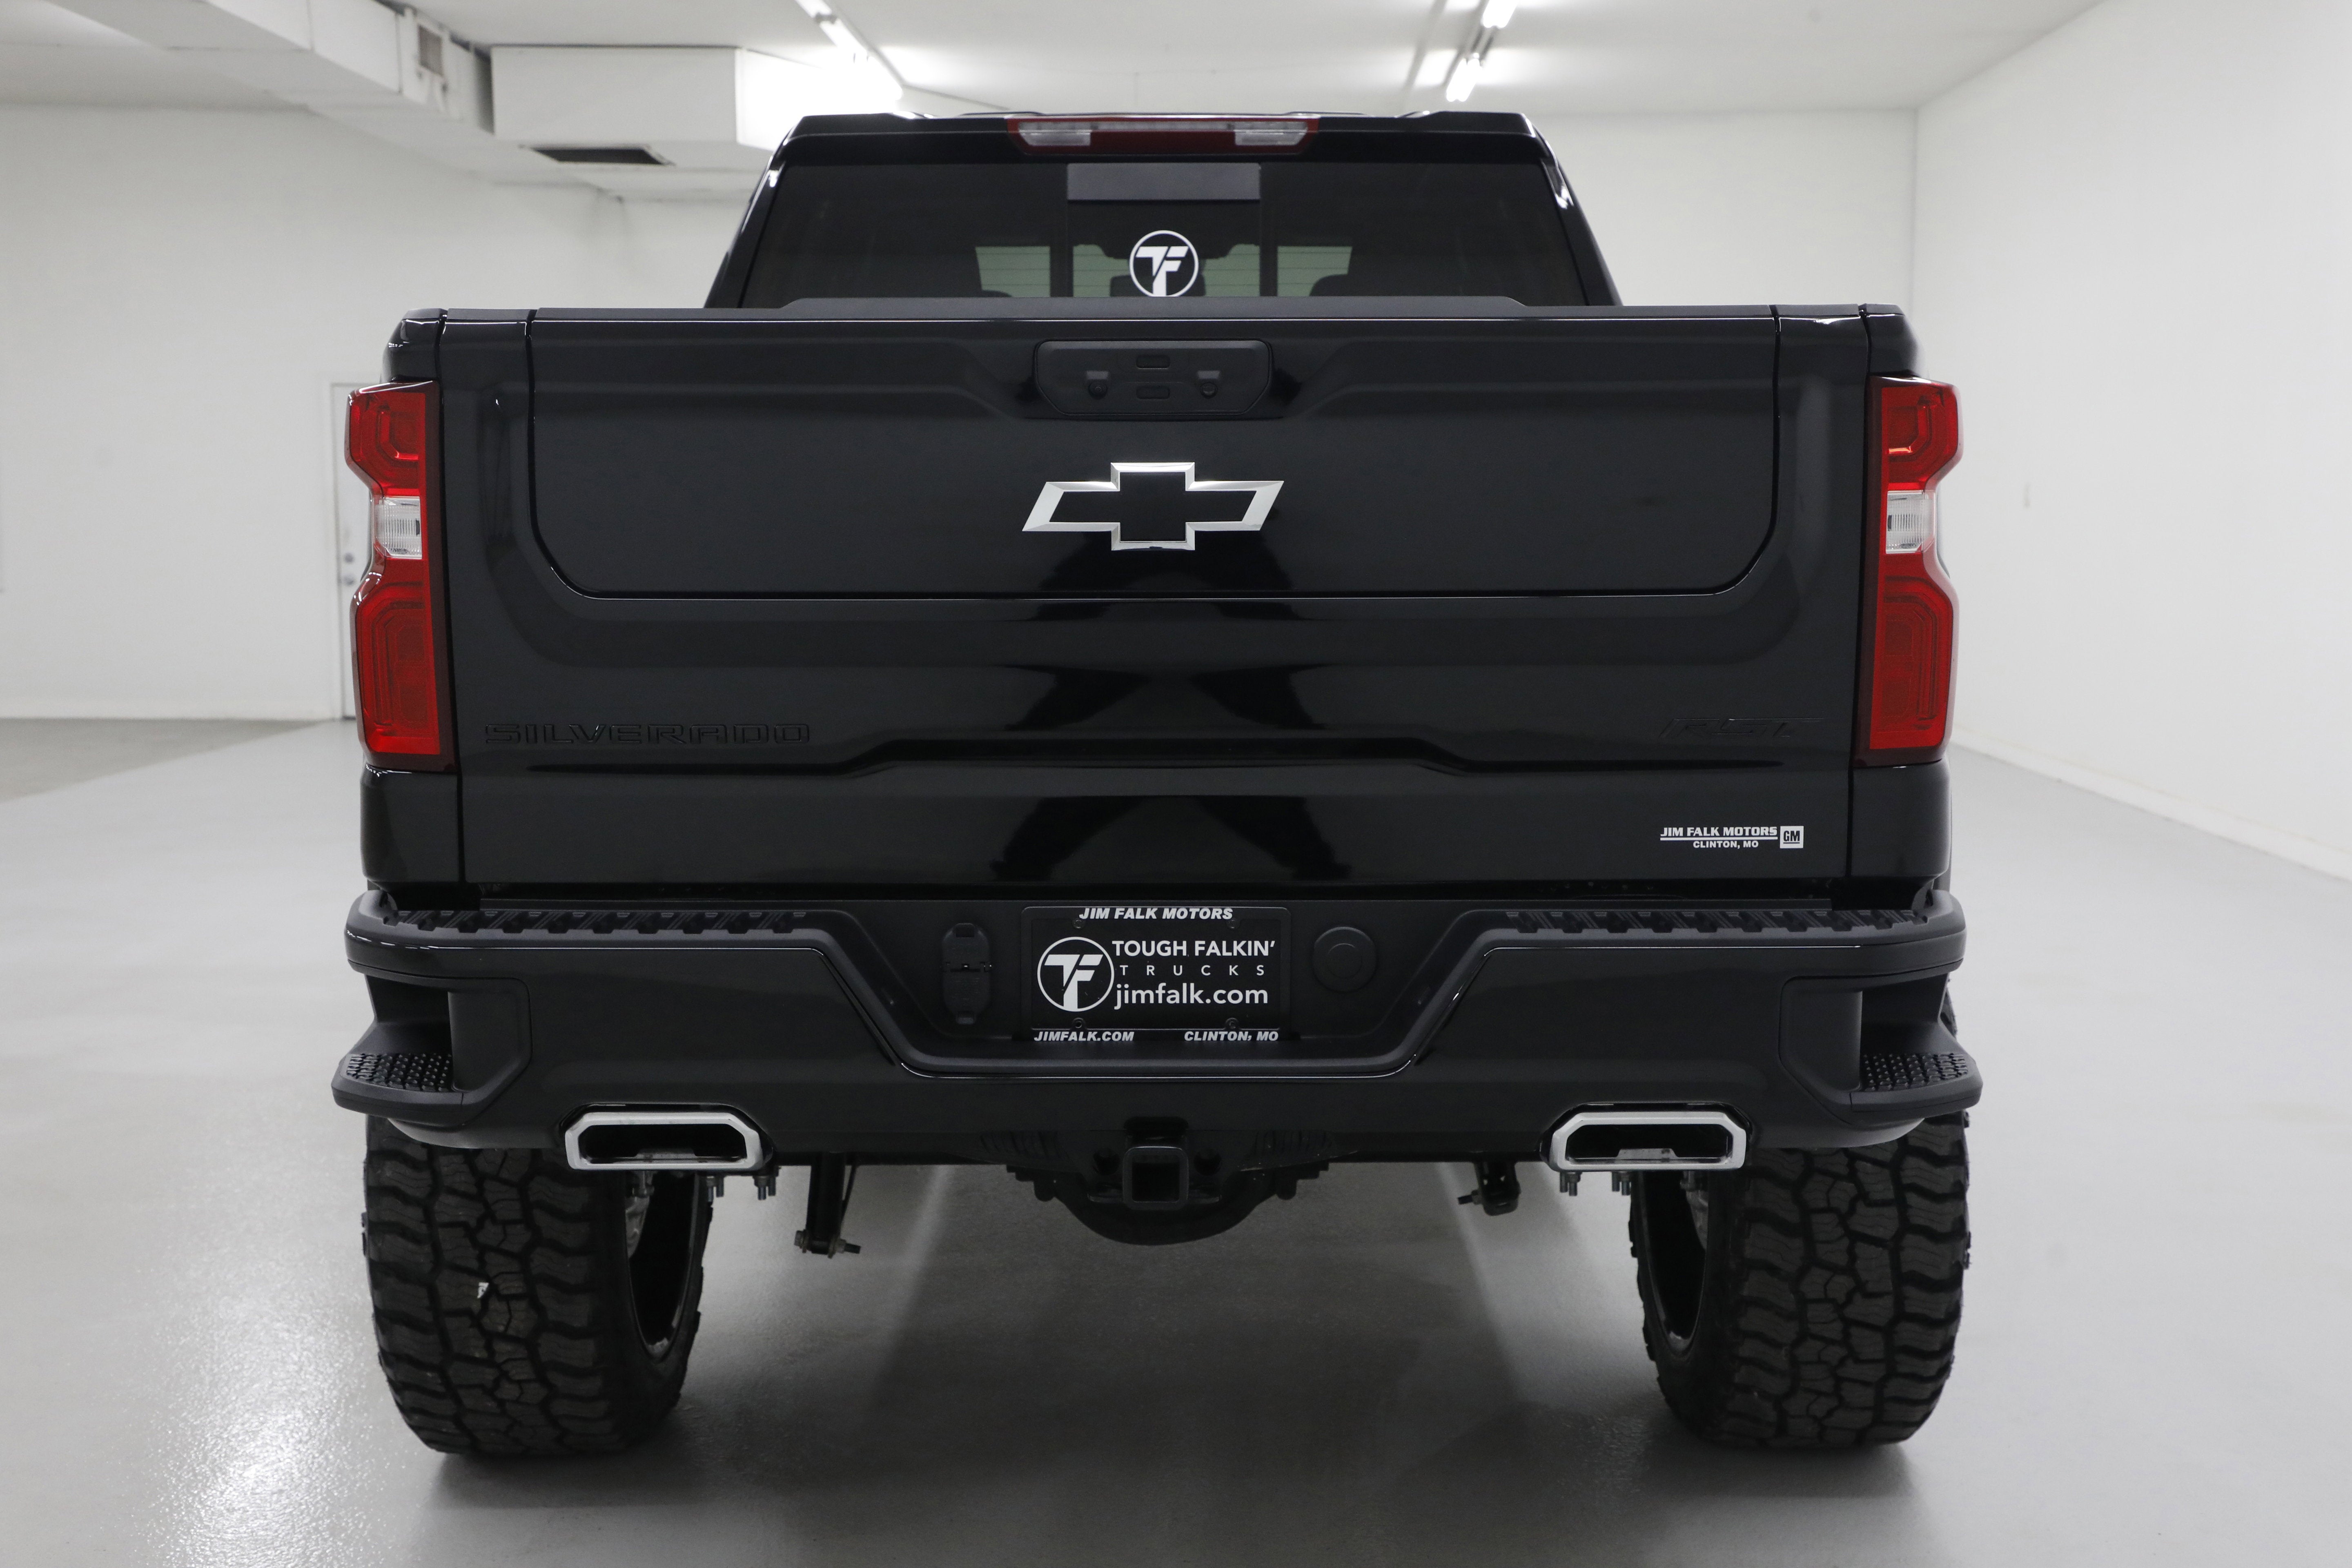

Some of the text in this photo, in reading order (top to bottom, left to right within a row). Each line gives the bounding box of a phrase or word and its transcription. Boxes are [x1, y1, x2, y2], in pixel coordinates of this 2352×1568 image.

[1136, 246, 1189, 296] TF
[1658, 717, 1824, 738] RST
[485, 724, 810, 745] SILVERADO
[1661, 827, 1777, 836] JIM FALK MOTORS
[1784, 831, 1800, 841] GM
[1693, 841, 1740, 849] CLINTON,
[1079, 908, 1233, 919] JIM FALK MOTORS
[1112, 940, 1275, 956] TOUGH FALKIN'
[1120, 965, 1264, 976] TRUCKS
[1044, 954, 1104, 1010] TF
[1114, 983, 1267, 1009] jimfalk.com
[1034, 1031, 1134, 1041] JIMFALK.COM
[1185, 1031, 1278, 1041] CLINTON, MO
